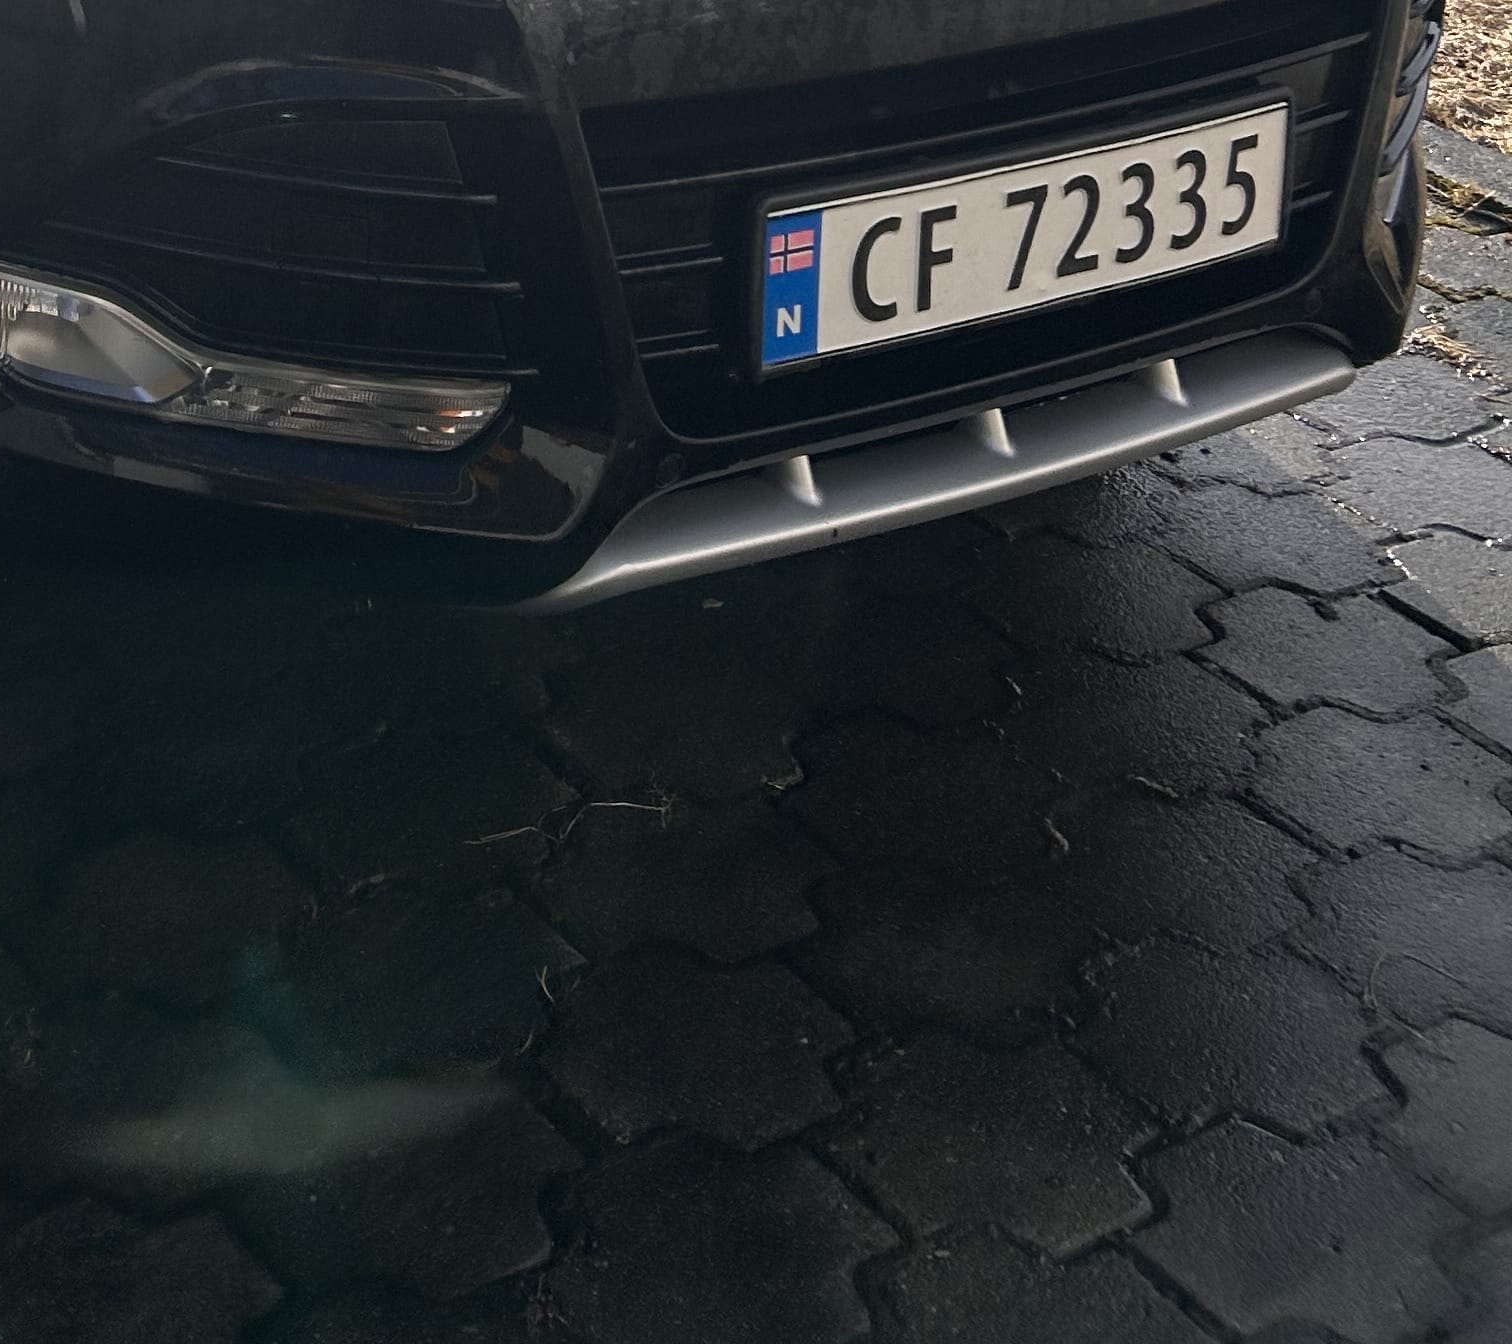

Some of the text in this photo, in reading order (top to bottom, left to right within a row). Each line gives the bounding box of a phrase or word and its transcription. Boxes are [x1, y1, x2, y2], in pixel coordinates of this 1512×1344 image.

[851, 134, 1258, 322] CF 72335
[776, 304, 801, 338] N
